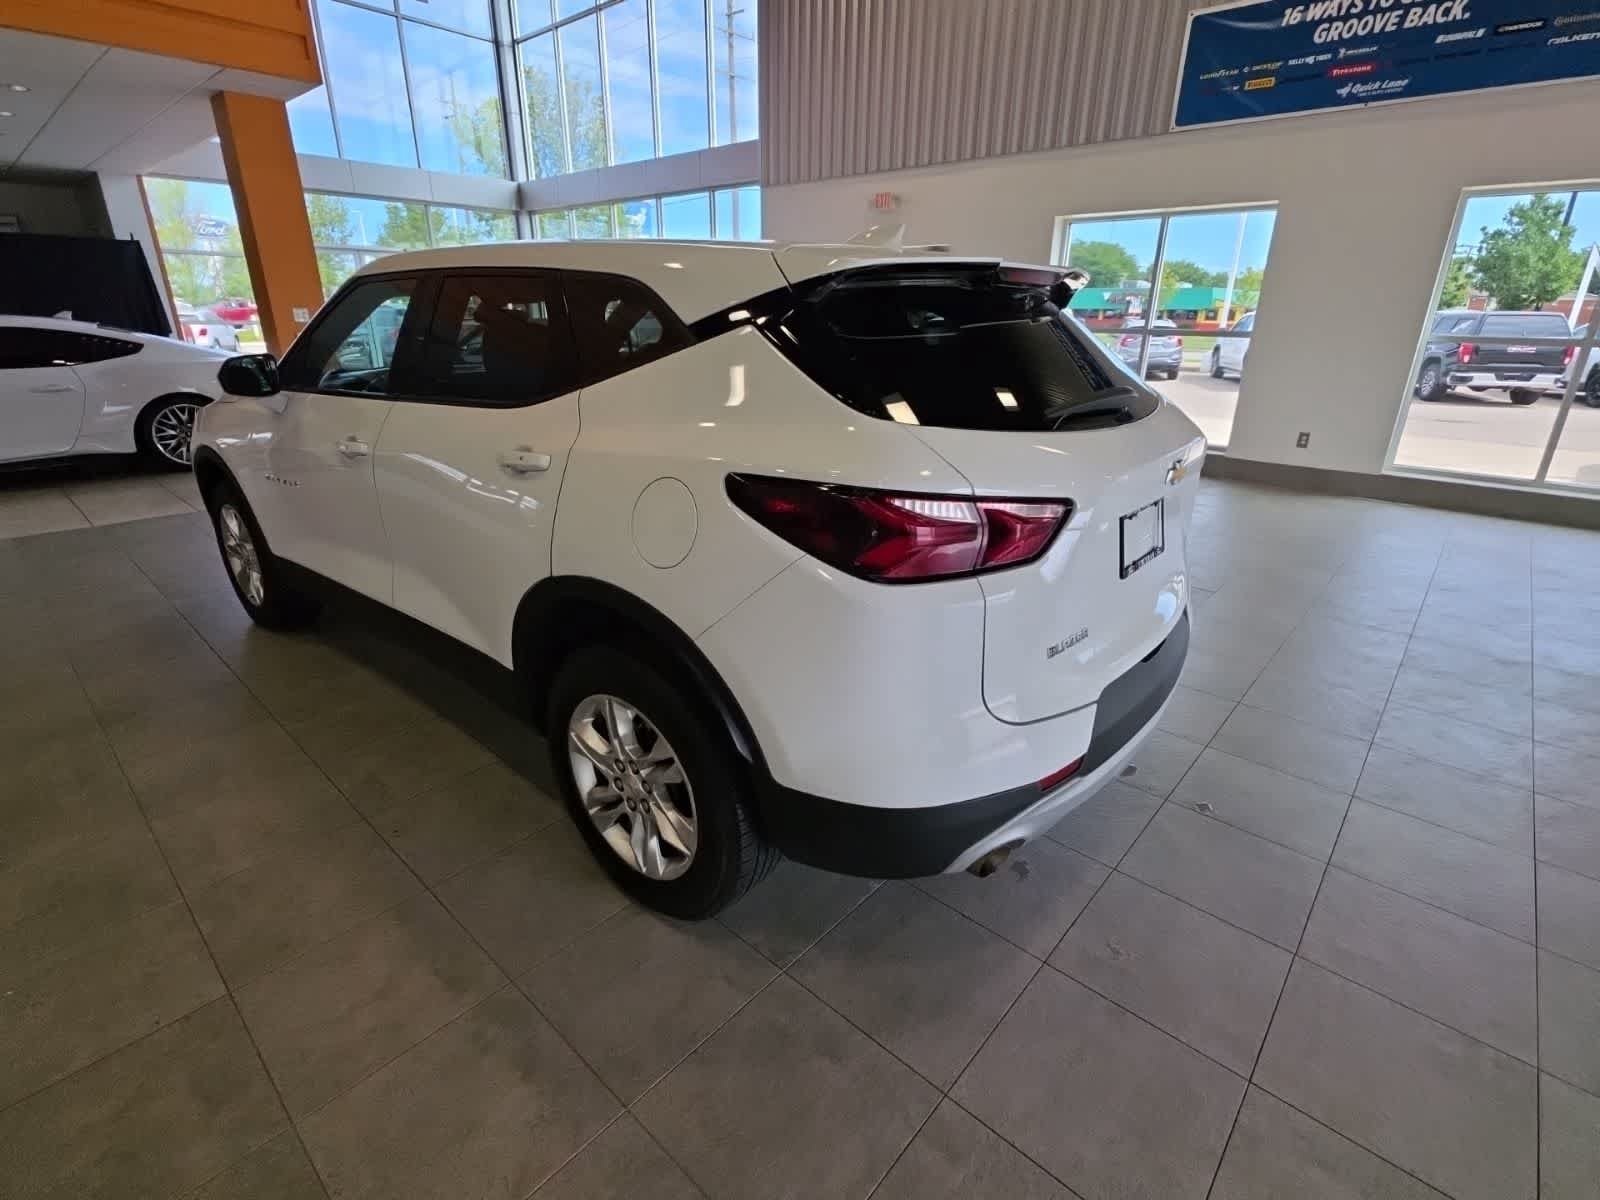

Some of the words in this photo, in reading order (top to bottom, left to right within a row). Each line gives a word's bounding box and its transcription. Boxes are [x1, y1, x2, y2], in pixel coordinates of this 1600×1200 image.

[1281, 6, 1304, 26] 16
[1305, 0, 1365, 21] WAYS
[1313, 9, 1404, 44] GROOVE
[1403, 0, 1471, 29] BACK.
[1350, 80, 1381, 94] Quick
[1381, 79, 1410, 89] Lane
